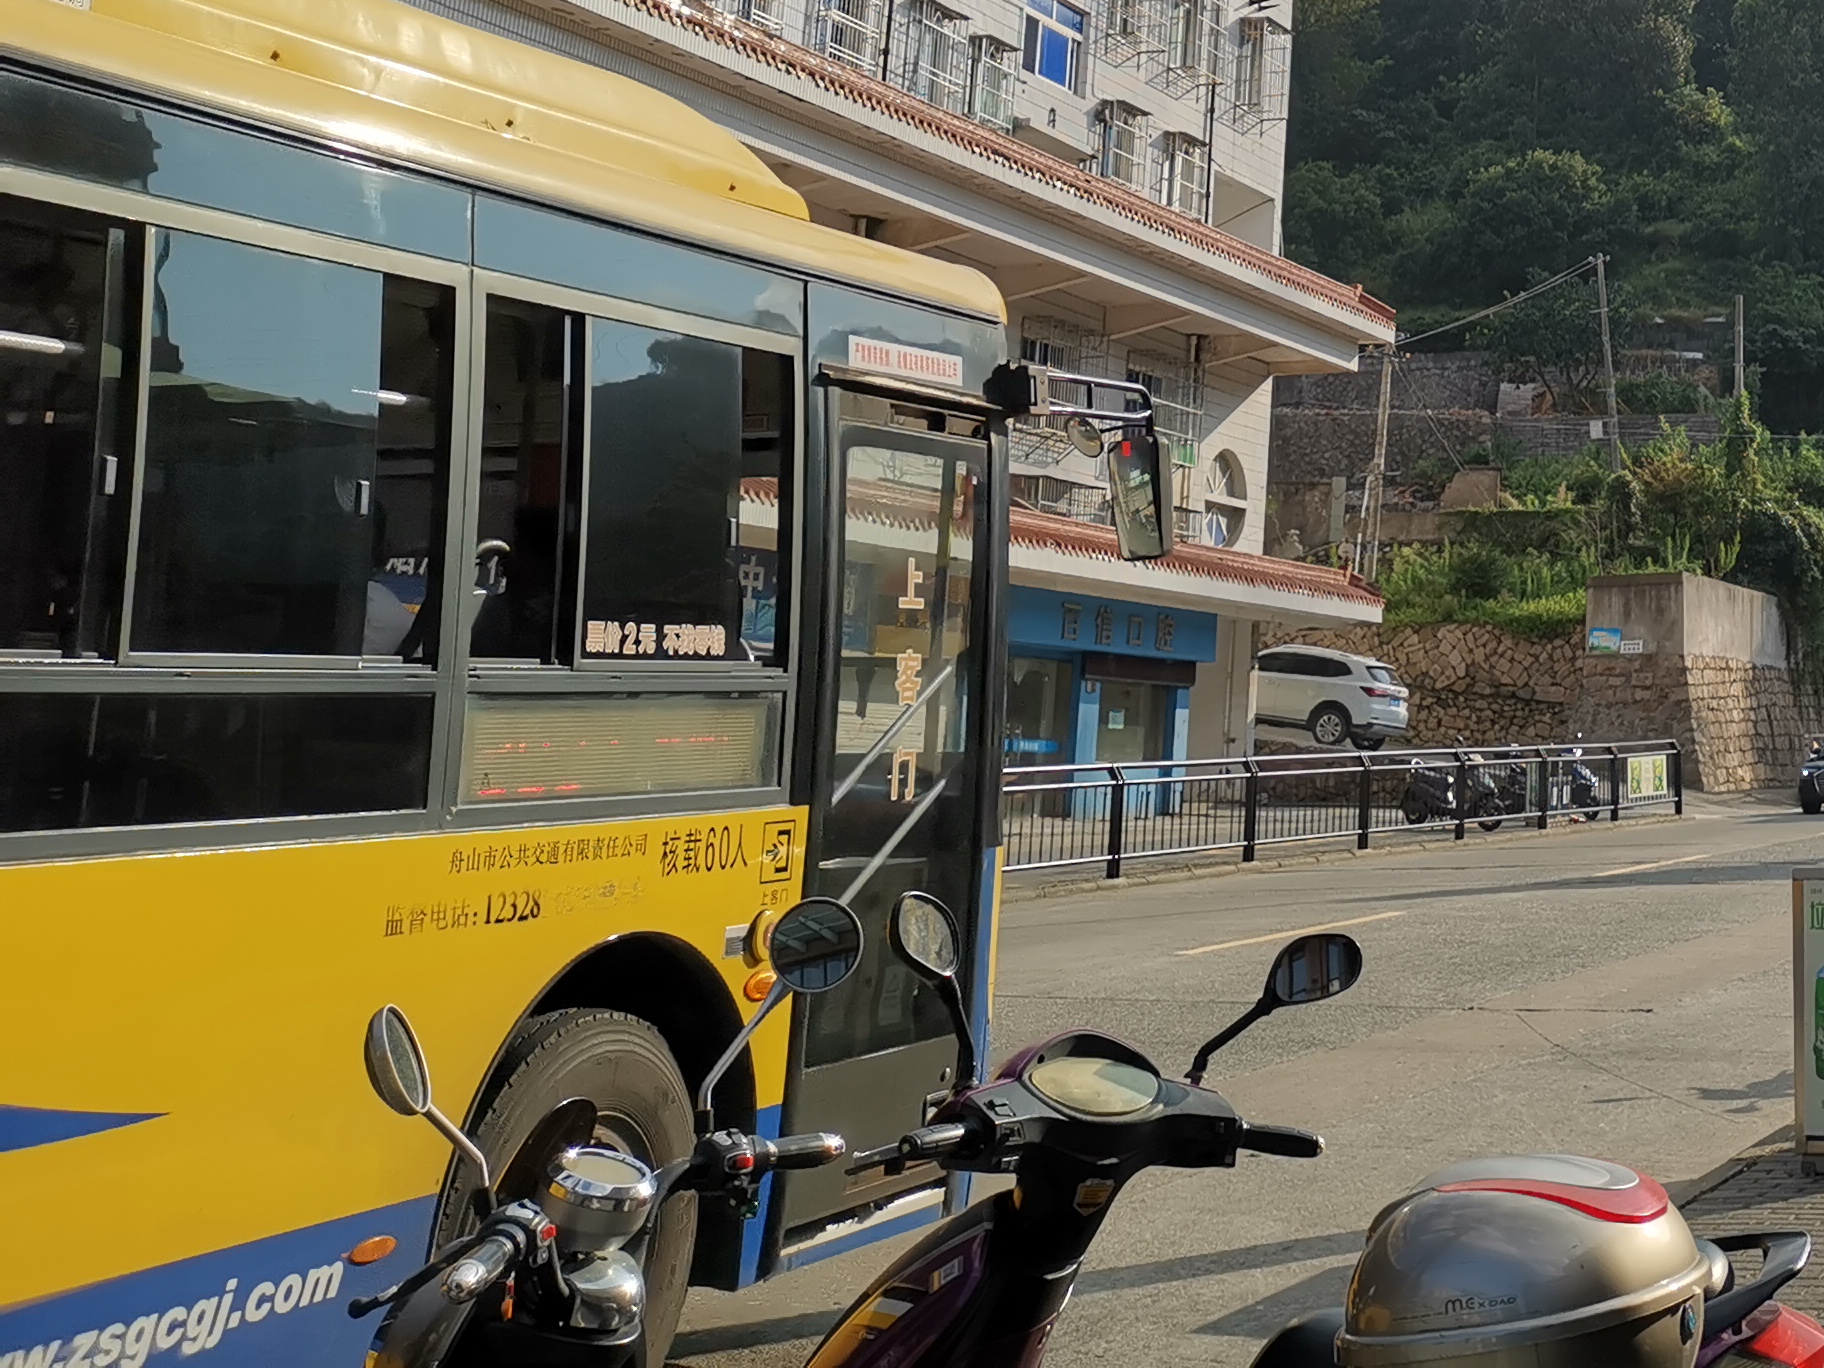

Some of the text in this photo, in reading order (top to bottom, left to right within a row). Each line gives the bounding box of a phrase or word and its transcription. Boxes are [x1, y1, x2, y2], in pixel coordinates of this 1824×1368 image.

[586, 621, 726, 656] 票价2元 不找零钱
[1061, 601, 1175, 652] 百信口腔
[448, 833, 648, 875] 舟山市公共交通有限责任公司
[660, 823, 748, 878] 核载60人
[760, 888, 789, 907] 上客门
